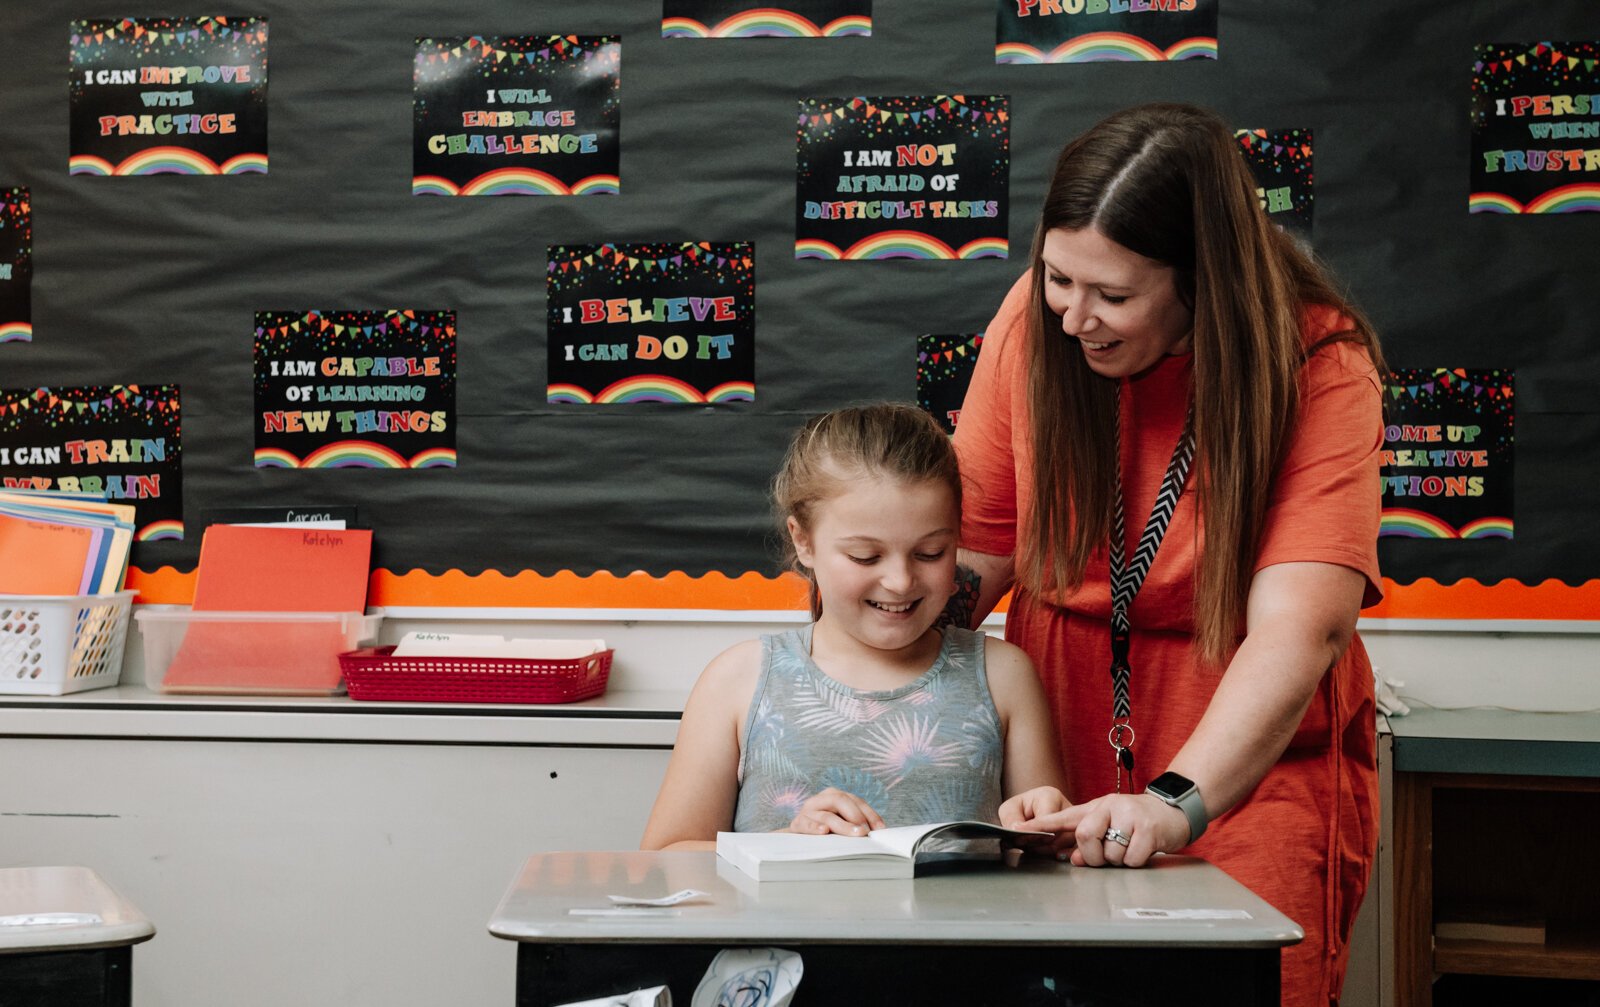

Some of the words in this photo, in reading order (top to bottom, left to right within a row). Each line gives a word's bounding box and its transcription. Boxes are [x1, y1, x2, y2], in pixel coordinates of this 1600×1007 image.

[85, 70, 93, 85] I
[96, 69, 136, 85] CAN
[139, 65, 250, 84] IMPROVE
[140, 90, 194, 107] WITH
[486, 89, 496, 104] I
[498, 89, 552, 104] WILL
[1495, 99, 1506, 116] I
[99, 113, 236, 136] PRACTICE
[462, 110, 575, 127] EMBRACE
[1528, 121, 1600, 139] WHEN
[428, 133, 598, 155] CHALLENGE
[843, 150, 853, 167] I
[856, 150, 892, 167] AM
[896, 143, 956, 167] NOT
[836, 174, 925, 193] AFRAID
[930, 174, 959, 192] OF
[803, 200, 925, 220] DIFFICULT
[929, 200, 998, 219] TASKS
[562, 307, 572, 323] I
[579, 296, 736, 324] BELIEVE
[564, 345, 574, 361] I
[578, 343, 628, 361] CAN
[635, 334, 688, 360] DO
[696, 334, 734, 360] IT
[270, 361, 279, 376] I
[282, 361, 316, 376] AM
[321, 356, 441, 377] CAPABLE
[285, 385, 313, 402] OF
[316, 385, 426, 402] LEARNING
[263, 410, 331, 433] NEW
[336, 409, 447, 434] THINGS
[1385, 424, 1442, 443] OME
[1446, 425, 1481, 443] UP
[0, 447, 10, 465] I
[13, 446, 60, 465] CAN
[65, 437, 165, 465] TRAIN
[1380, 449, 1488, 468] REATIVE
[57, 473, 160, 499] BRAIN
